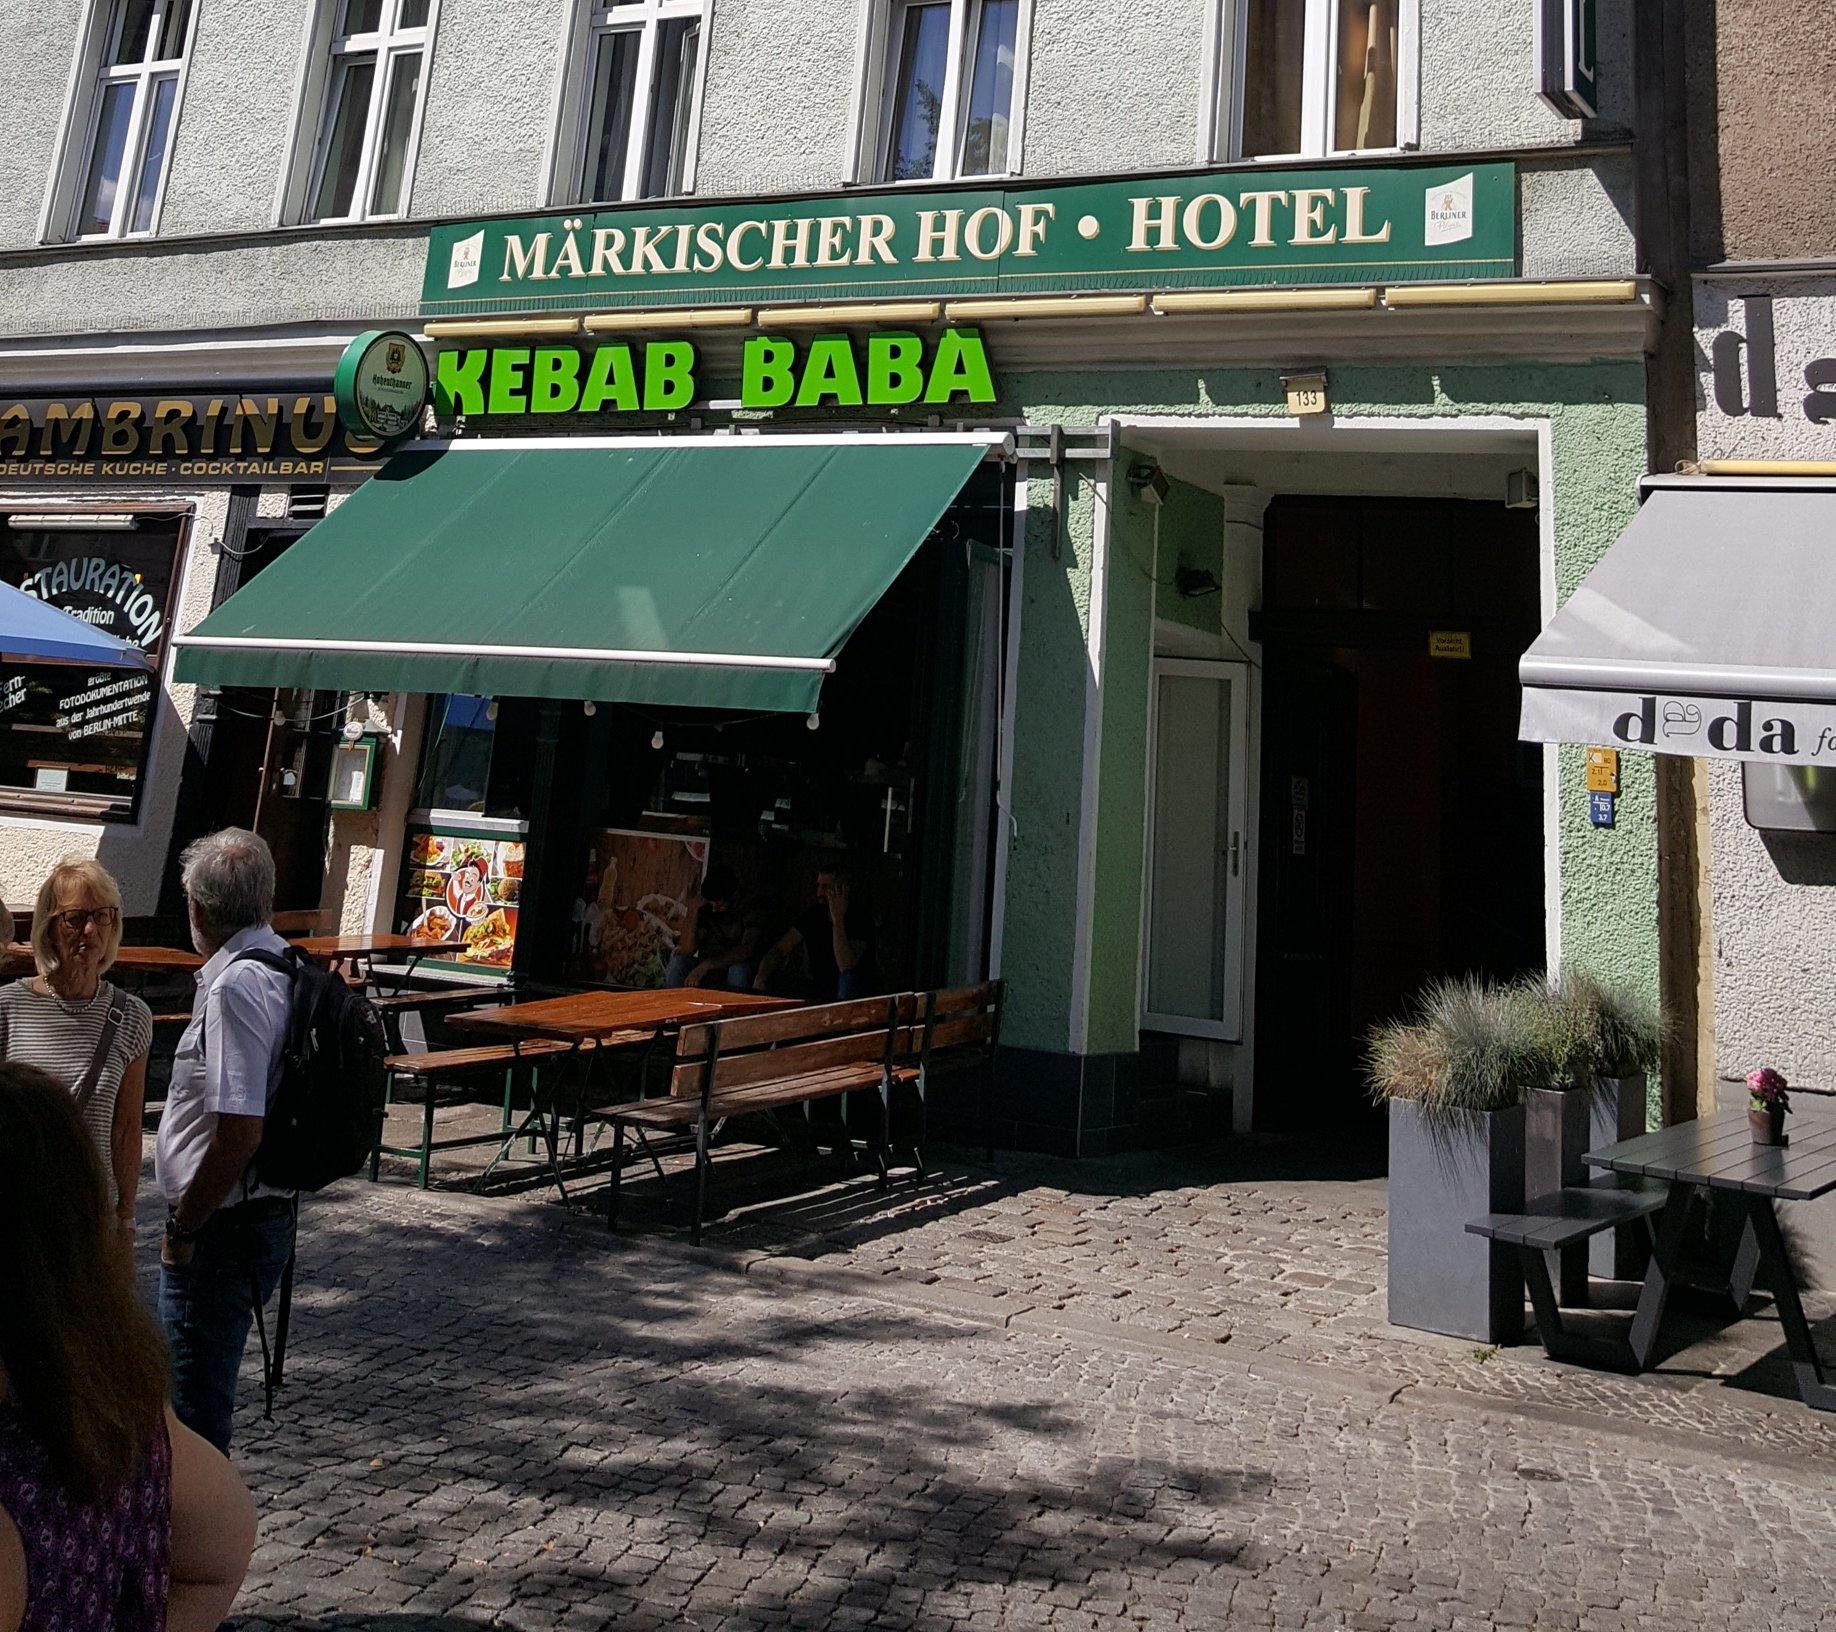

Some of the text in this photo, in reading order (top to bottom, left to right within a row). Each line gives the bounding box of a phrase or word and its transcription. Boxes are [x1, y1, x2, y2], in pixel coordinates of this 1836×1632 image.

[1430, 210, 1467, 221] BERLINER
[498, 187, 1392, 282] MÄRKISCHER HOF HOTEL
[435, 328, 996, 417] KEBAB BABA
[1296, 389, 1317, 406] 133
[0, 460, 324, 476] DEUTSCHE KÜCHE COCKTAILBAR
[59, 674, 148, 710] FOTODOKUMENTATION
[55, 691, 151, 728] aus der Jahrhundertwende
[68, 710, 139, 741] von BERLIN-MITTE
